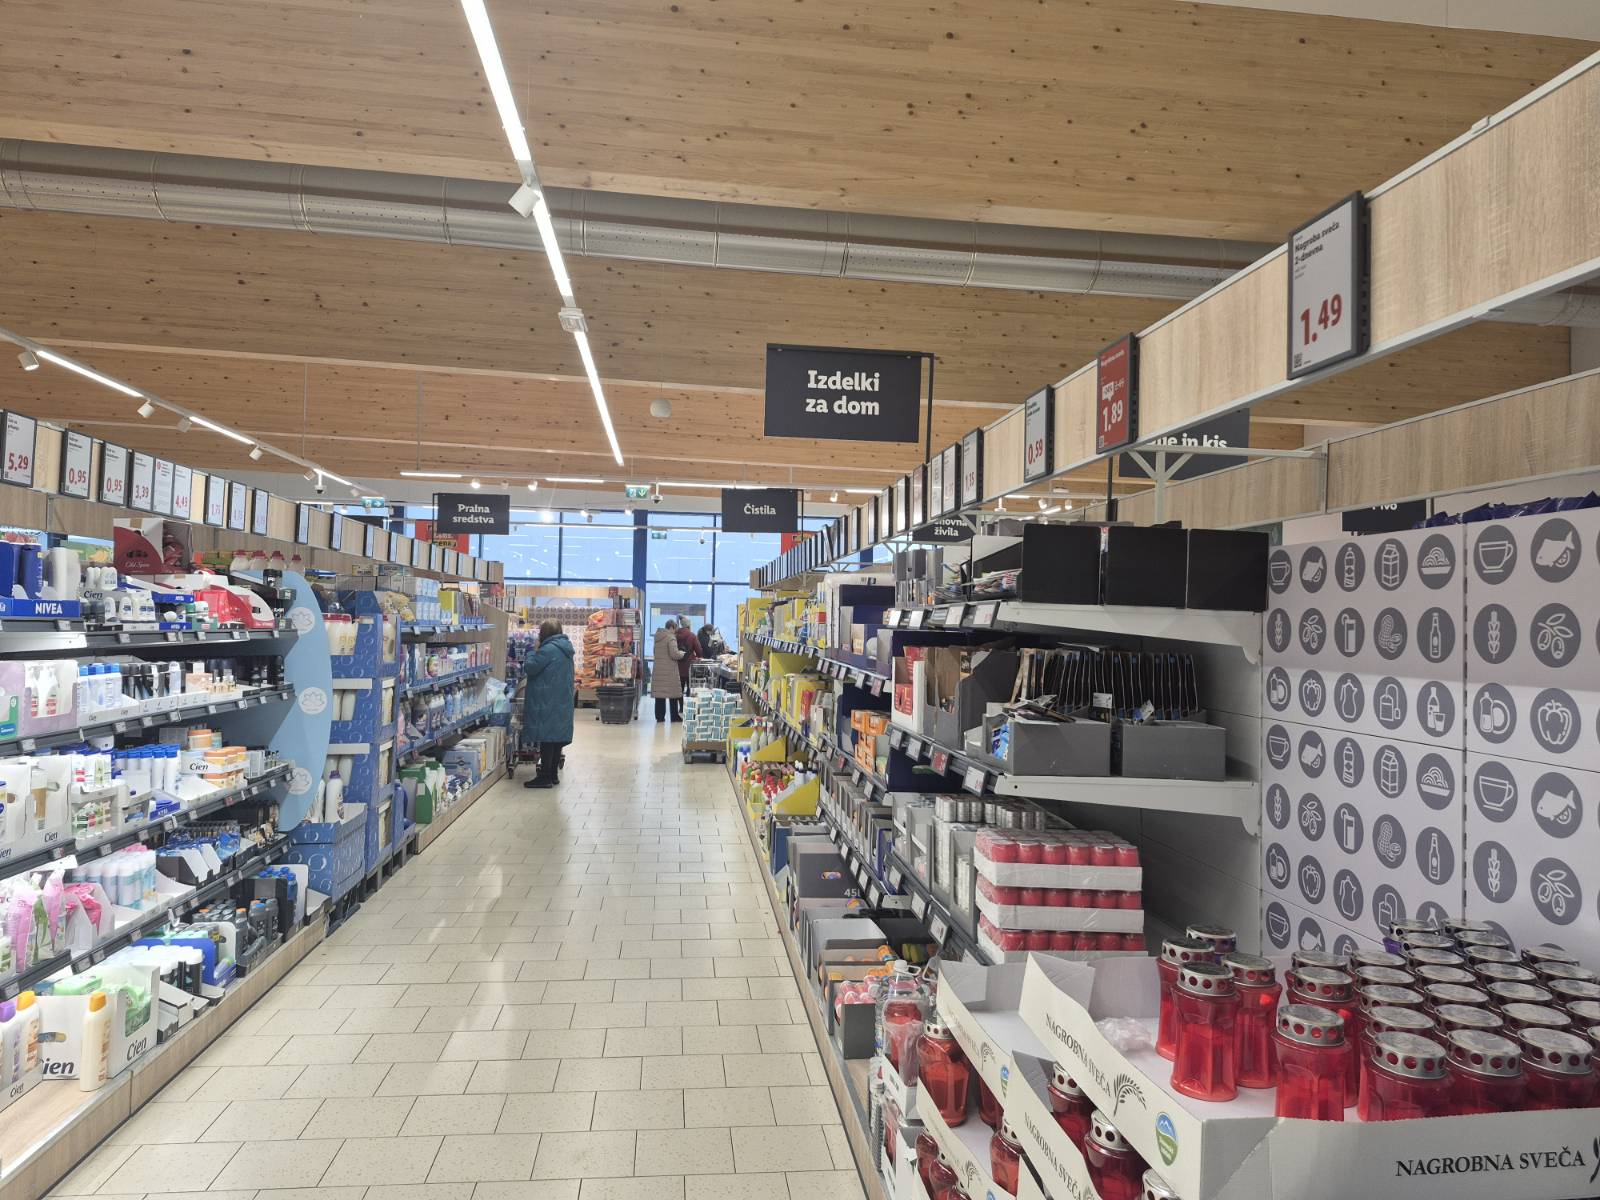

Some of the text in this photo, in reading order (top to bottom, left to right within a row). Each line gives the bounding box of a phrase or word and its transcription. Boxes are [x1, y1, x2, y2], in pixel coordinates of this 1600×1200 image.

[1300, 293, 1342, 345] 1.49
[807, 370, 881, 392] Izdelki
[805, 395, 880, 415] za dom
[1102, 399, 1124, 432] 1.89
[1203, 434, 1228, 449] kis
[457, 503, 490, 514] Pralna
[743, 503, 777, 516] Čistila
[452, 514, 495, 524] sredstva
[934, 526, 959, 537] živila
[35, 602, 63, 615] NIVEA
[189, 762, 209, 771] Cien
[44, 831, 58, 843] Cien
[0, 847, 12, 859] ien
[126, 1036, 148, 1062] Cien
[1045, 1013, 1112, 1097] NAGROBNA SVEČA
[40, 1057, 75, 1075] ien
[1024, 1112, 1059, 1174] NAGROBNA
[1395, 1146, 1586, 1177] NAGROBNA SVEČA
